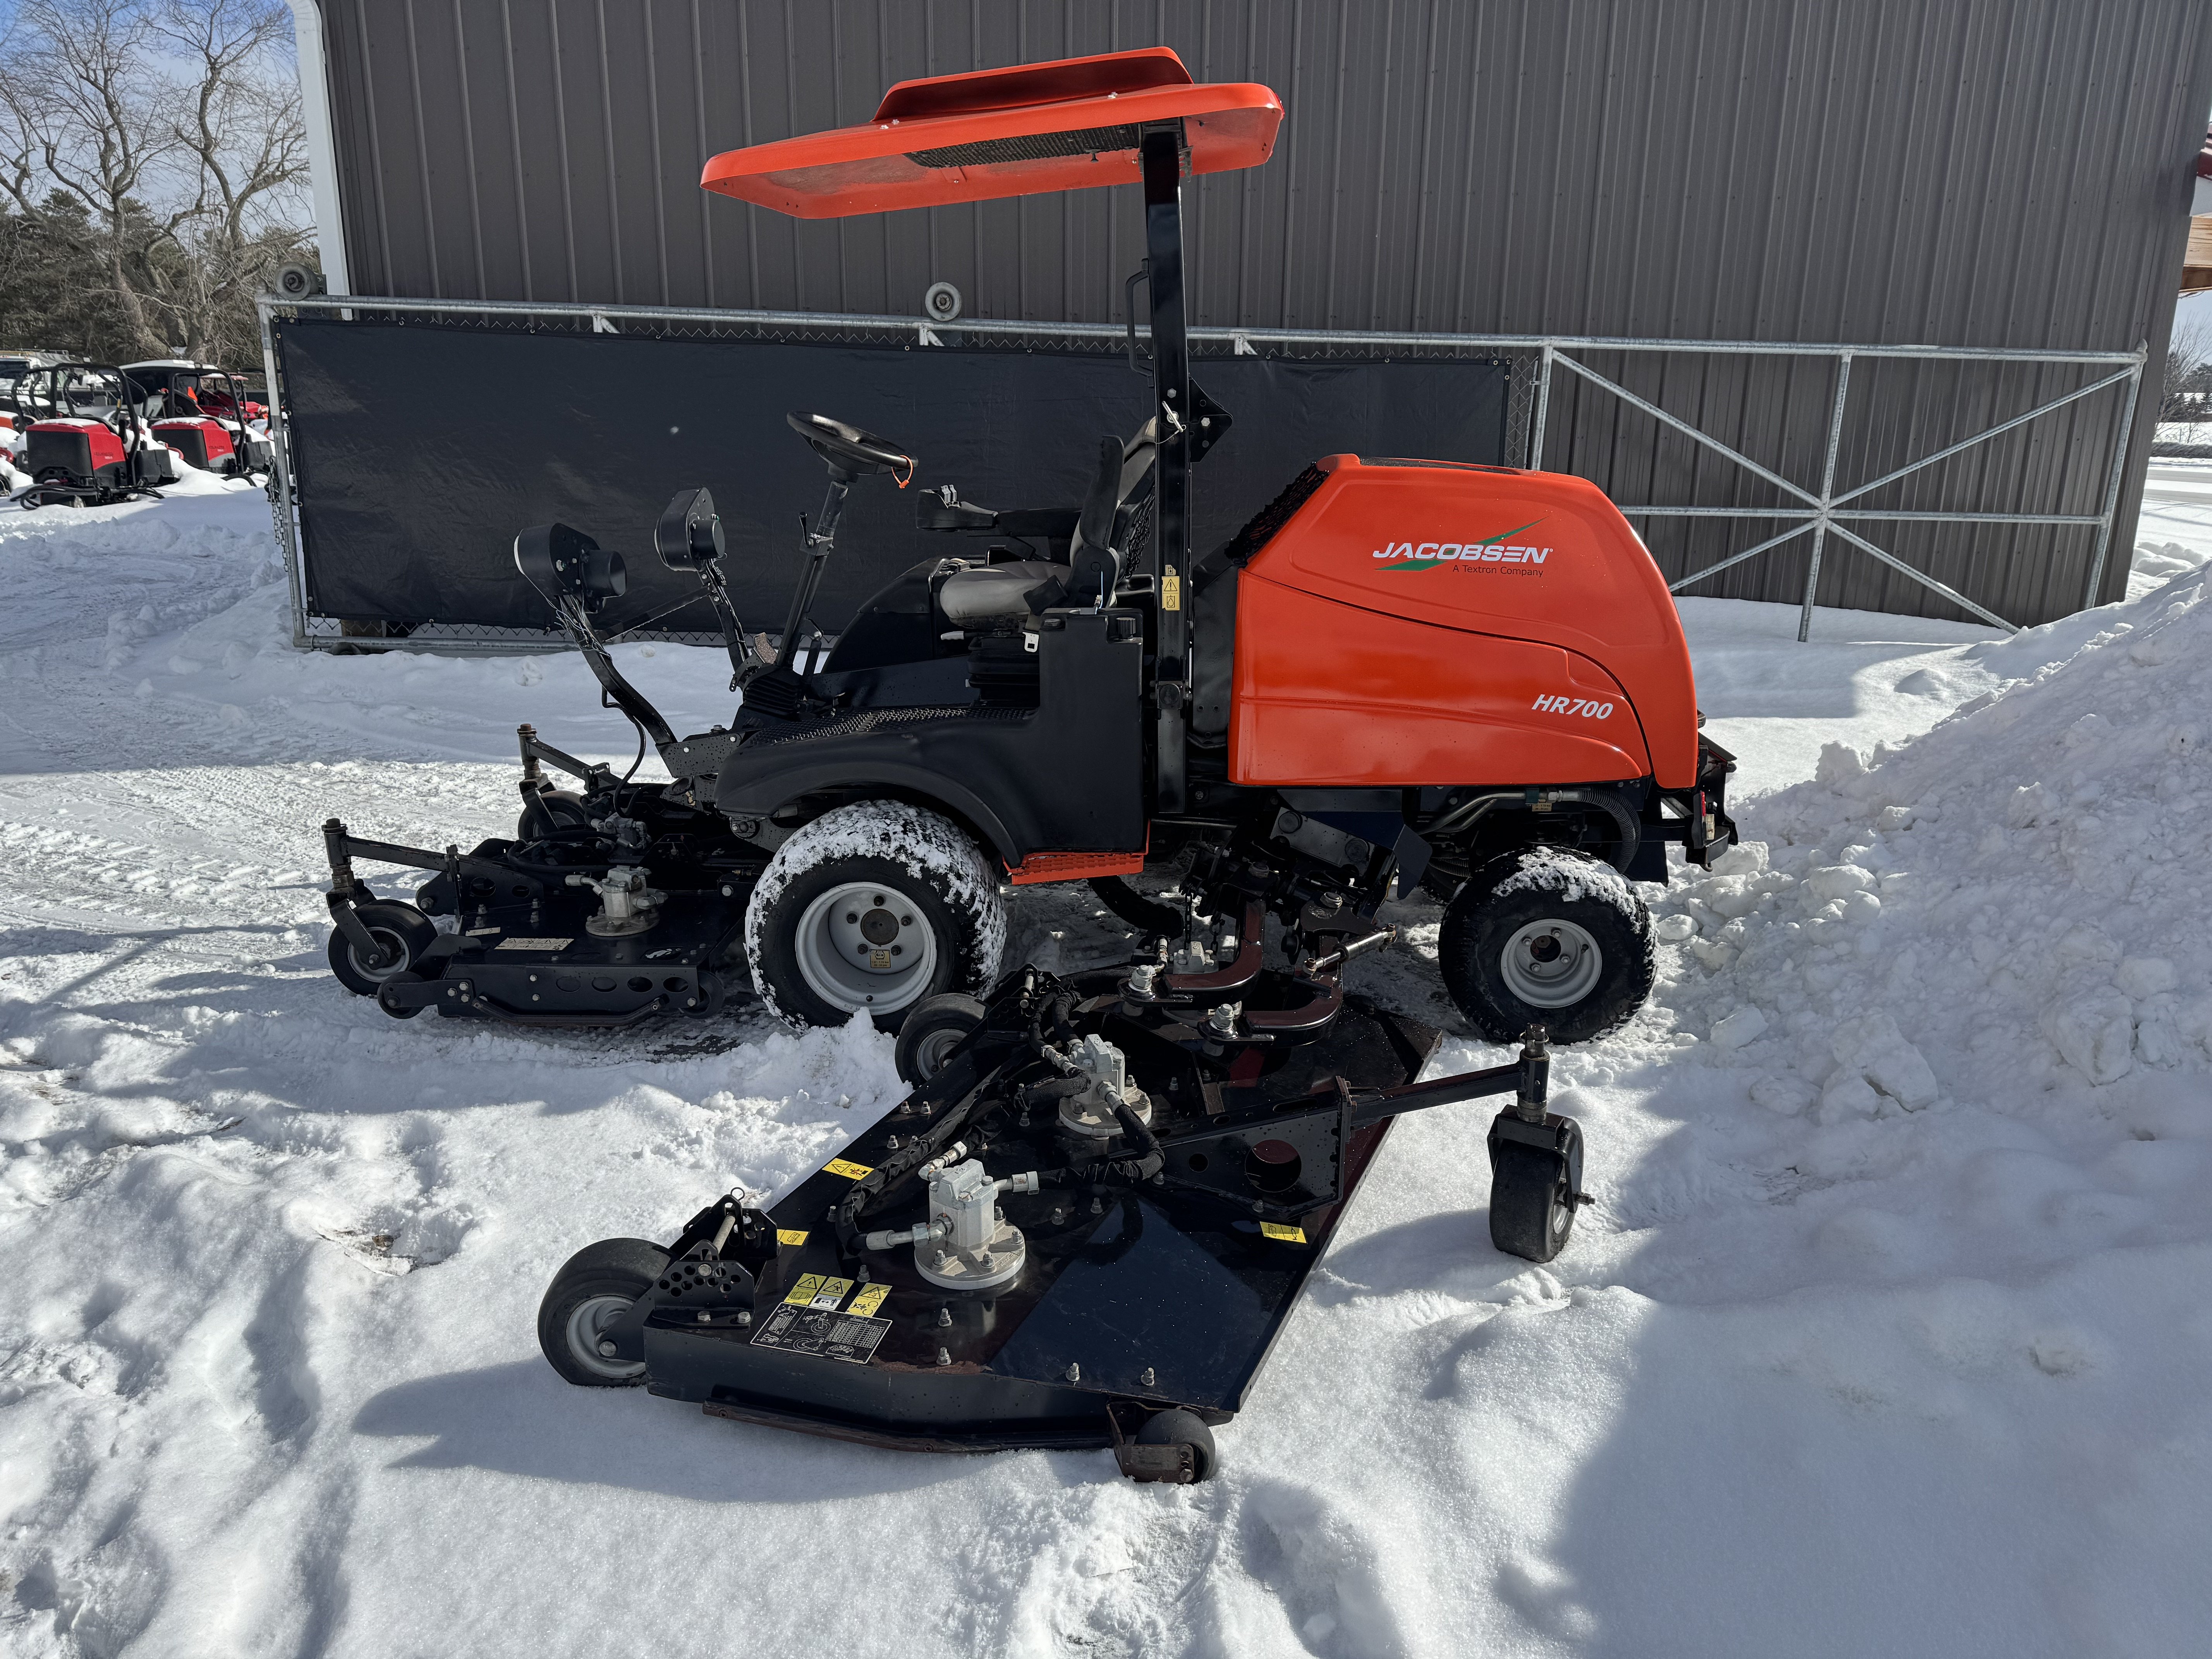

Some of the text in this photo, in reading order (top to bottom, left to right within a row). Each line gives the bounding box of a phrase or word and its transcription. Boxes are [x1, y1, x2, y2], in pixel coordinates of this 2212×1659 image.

[1373, 543, 1549, 563] JACOBSEN
[1462, 565, 1497, 574] Textron
[1500, 566, 1544, 577] Company
[1531, 694, 1613, 719] HR700
